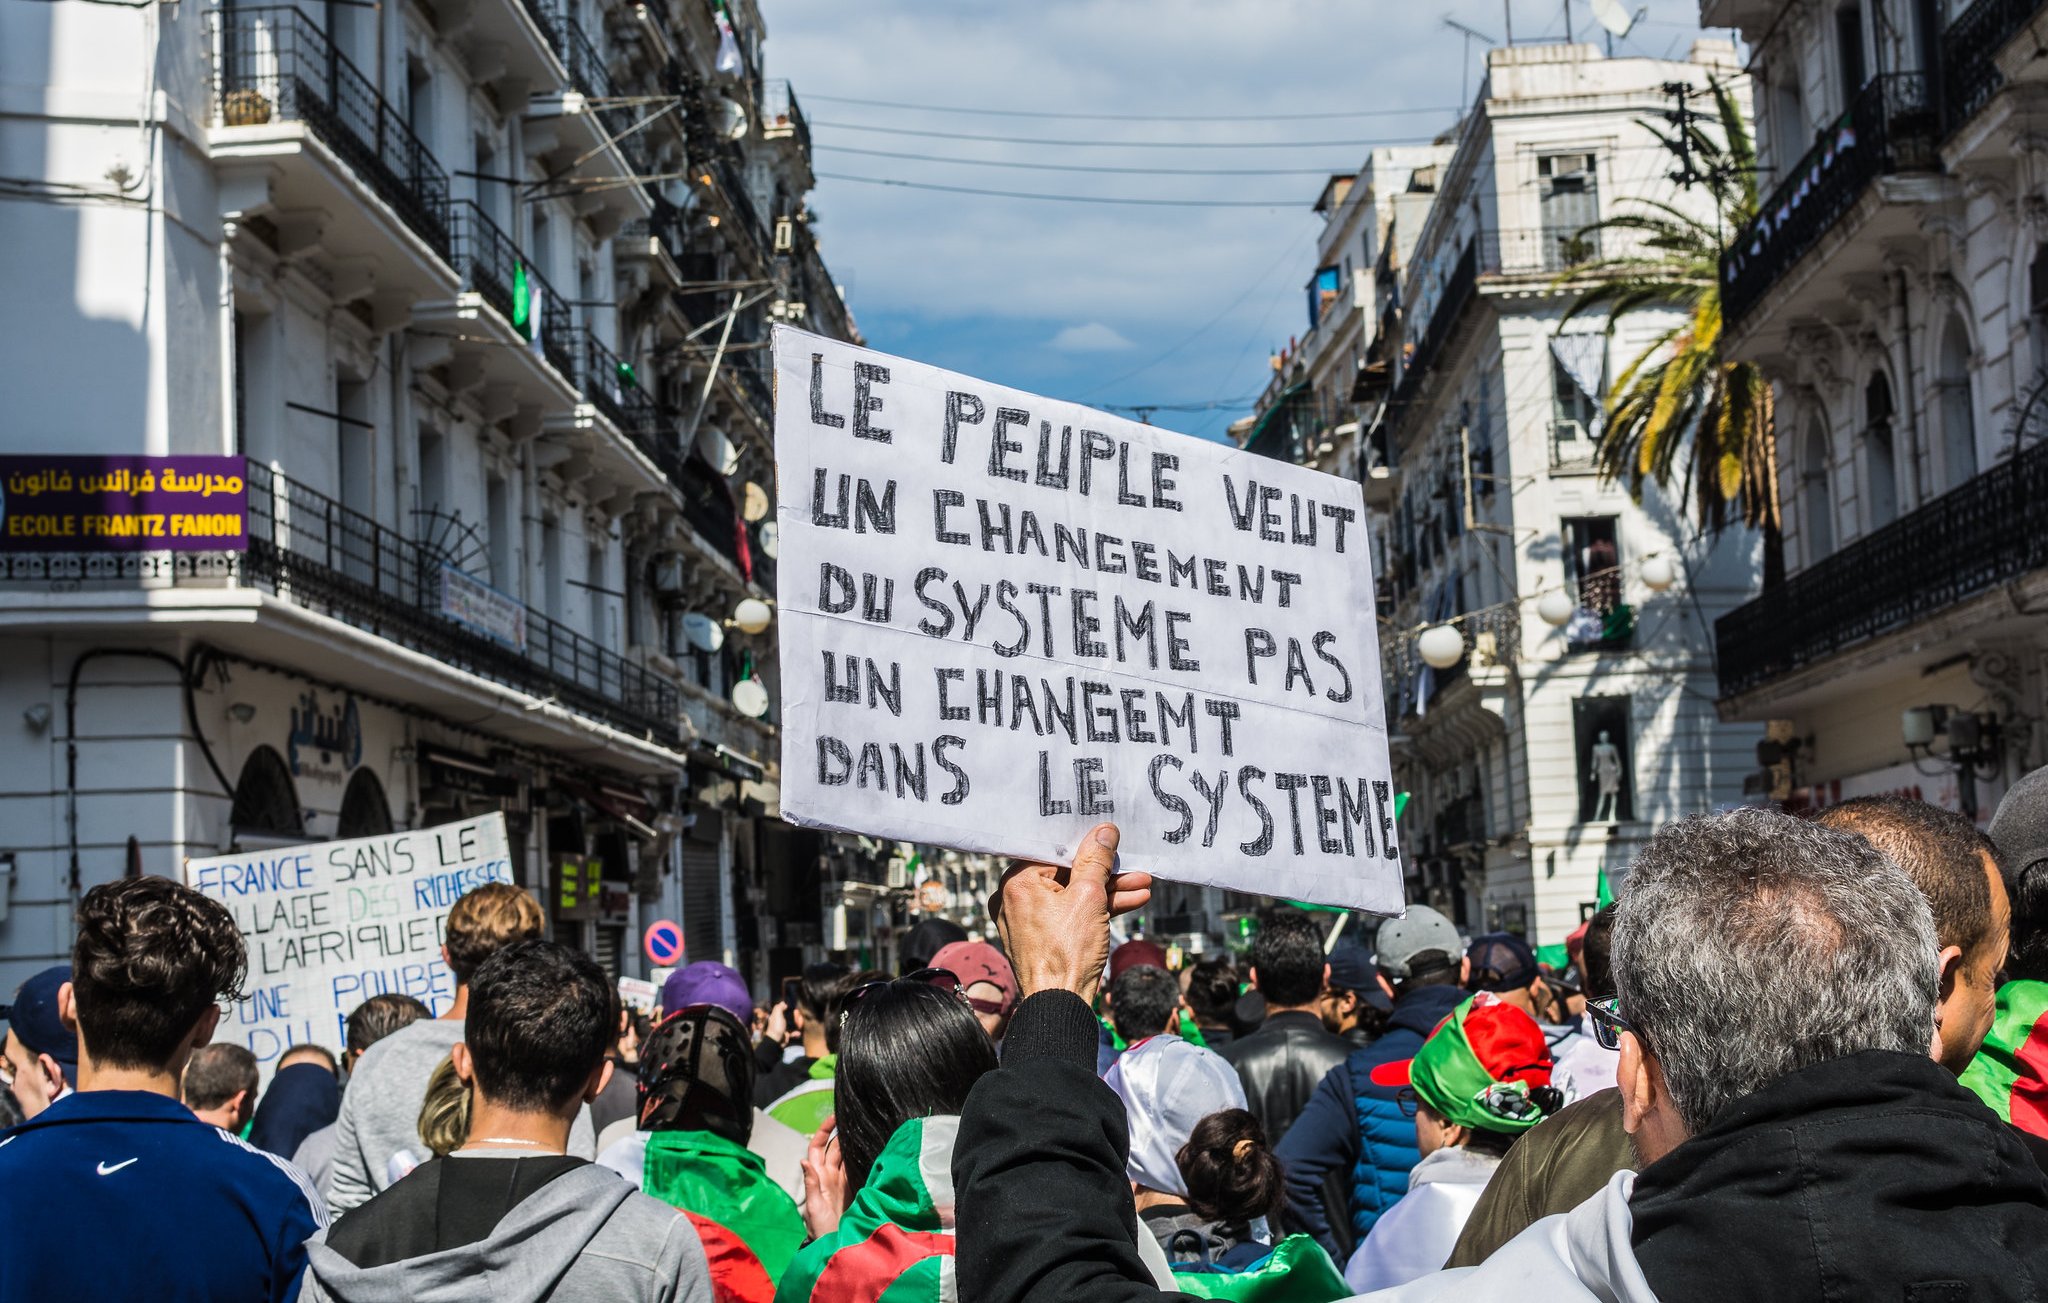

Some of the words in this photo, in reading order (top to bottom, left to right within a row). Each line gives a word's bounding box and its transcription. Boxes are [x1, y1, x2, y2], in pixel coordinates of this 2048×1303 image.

[9, 470, 73, 496] فانون
[160, 468, 243, 497] مدرسة
[810, 353, 892, 444] LE
[941, 391, 1183, 511] PEUPLE
[1223, 474, 1355, 553] VEUT
[8, 515, 75, 536] ECOLE
[83, 514, 165, 536] FRANTZ
[170, 514, 241, 536] FANON
[812, 467, 897, 534] UN
[933, 489, 1301, 607] CHANGEMENT
[818, 562, 894, 623] DU
[914, 567, 1200, 671] SYSTEME
[1244, 628, 1352, 702] PAS
[822, 650, 901, 717] UN
[934, 667, 1240, 757] CHANGEMT
[816, 734, 970, 805] DANS
[1039, 751, 1114, 817] LE
[1148, 753, 1398, 860] SYSTEME
[199, 855, 314, 899] FRANCE
[329, 837, 414, 883] SANS
[436, 826, 477, 867] LE
[347, 884, 401, 923] DES
[239, 984, 314, 1025] UNE
